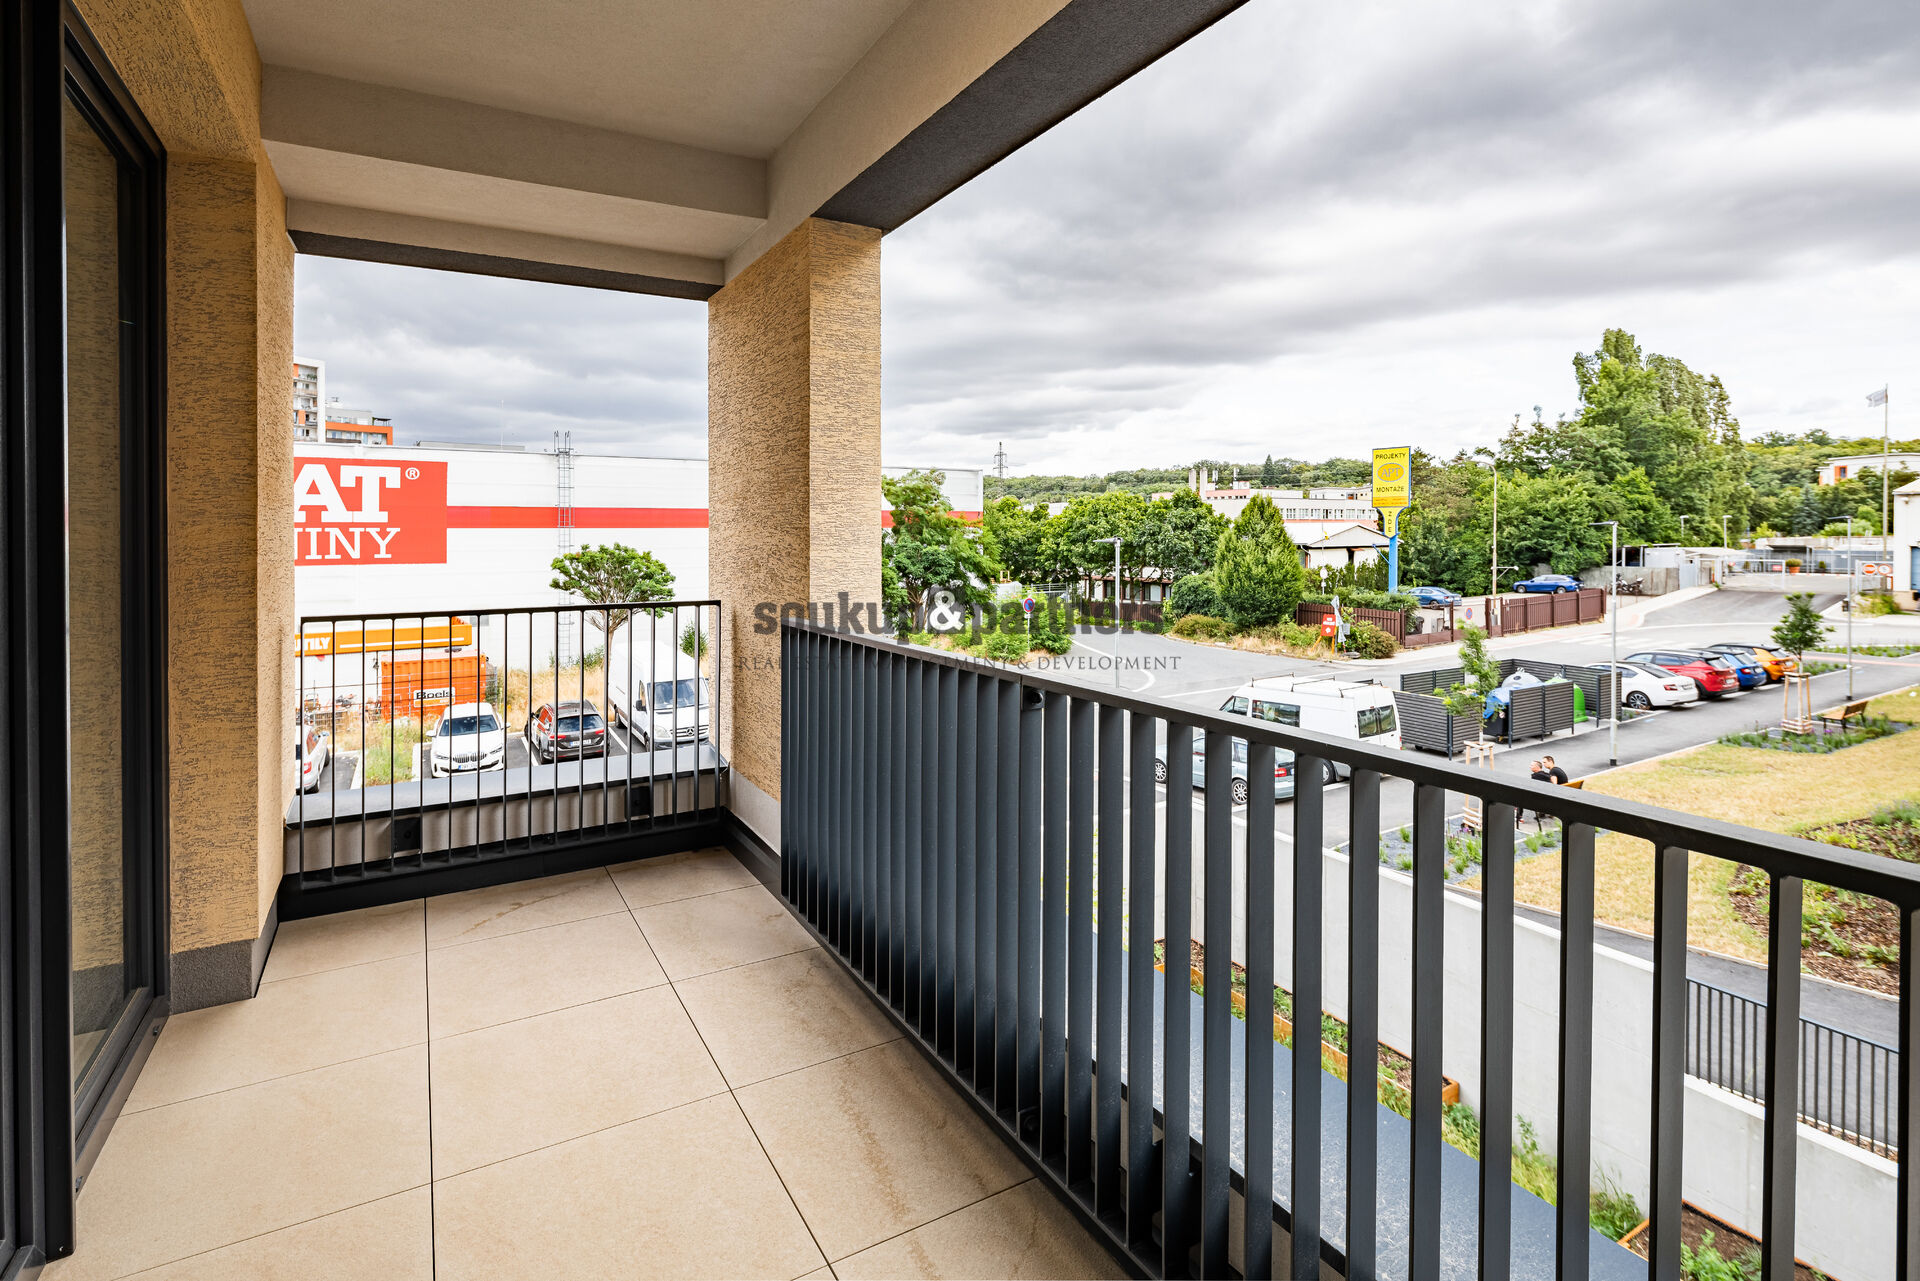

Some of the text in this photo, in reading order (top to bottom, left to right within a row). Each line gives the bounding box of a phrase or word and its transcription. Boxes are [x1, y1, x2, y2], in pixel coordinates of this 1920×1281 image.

[1375, 452, 1406, 460] PROJEKTY
[1381, 467, 1401, 478] APT
[294, 527, 401, 560] INY
